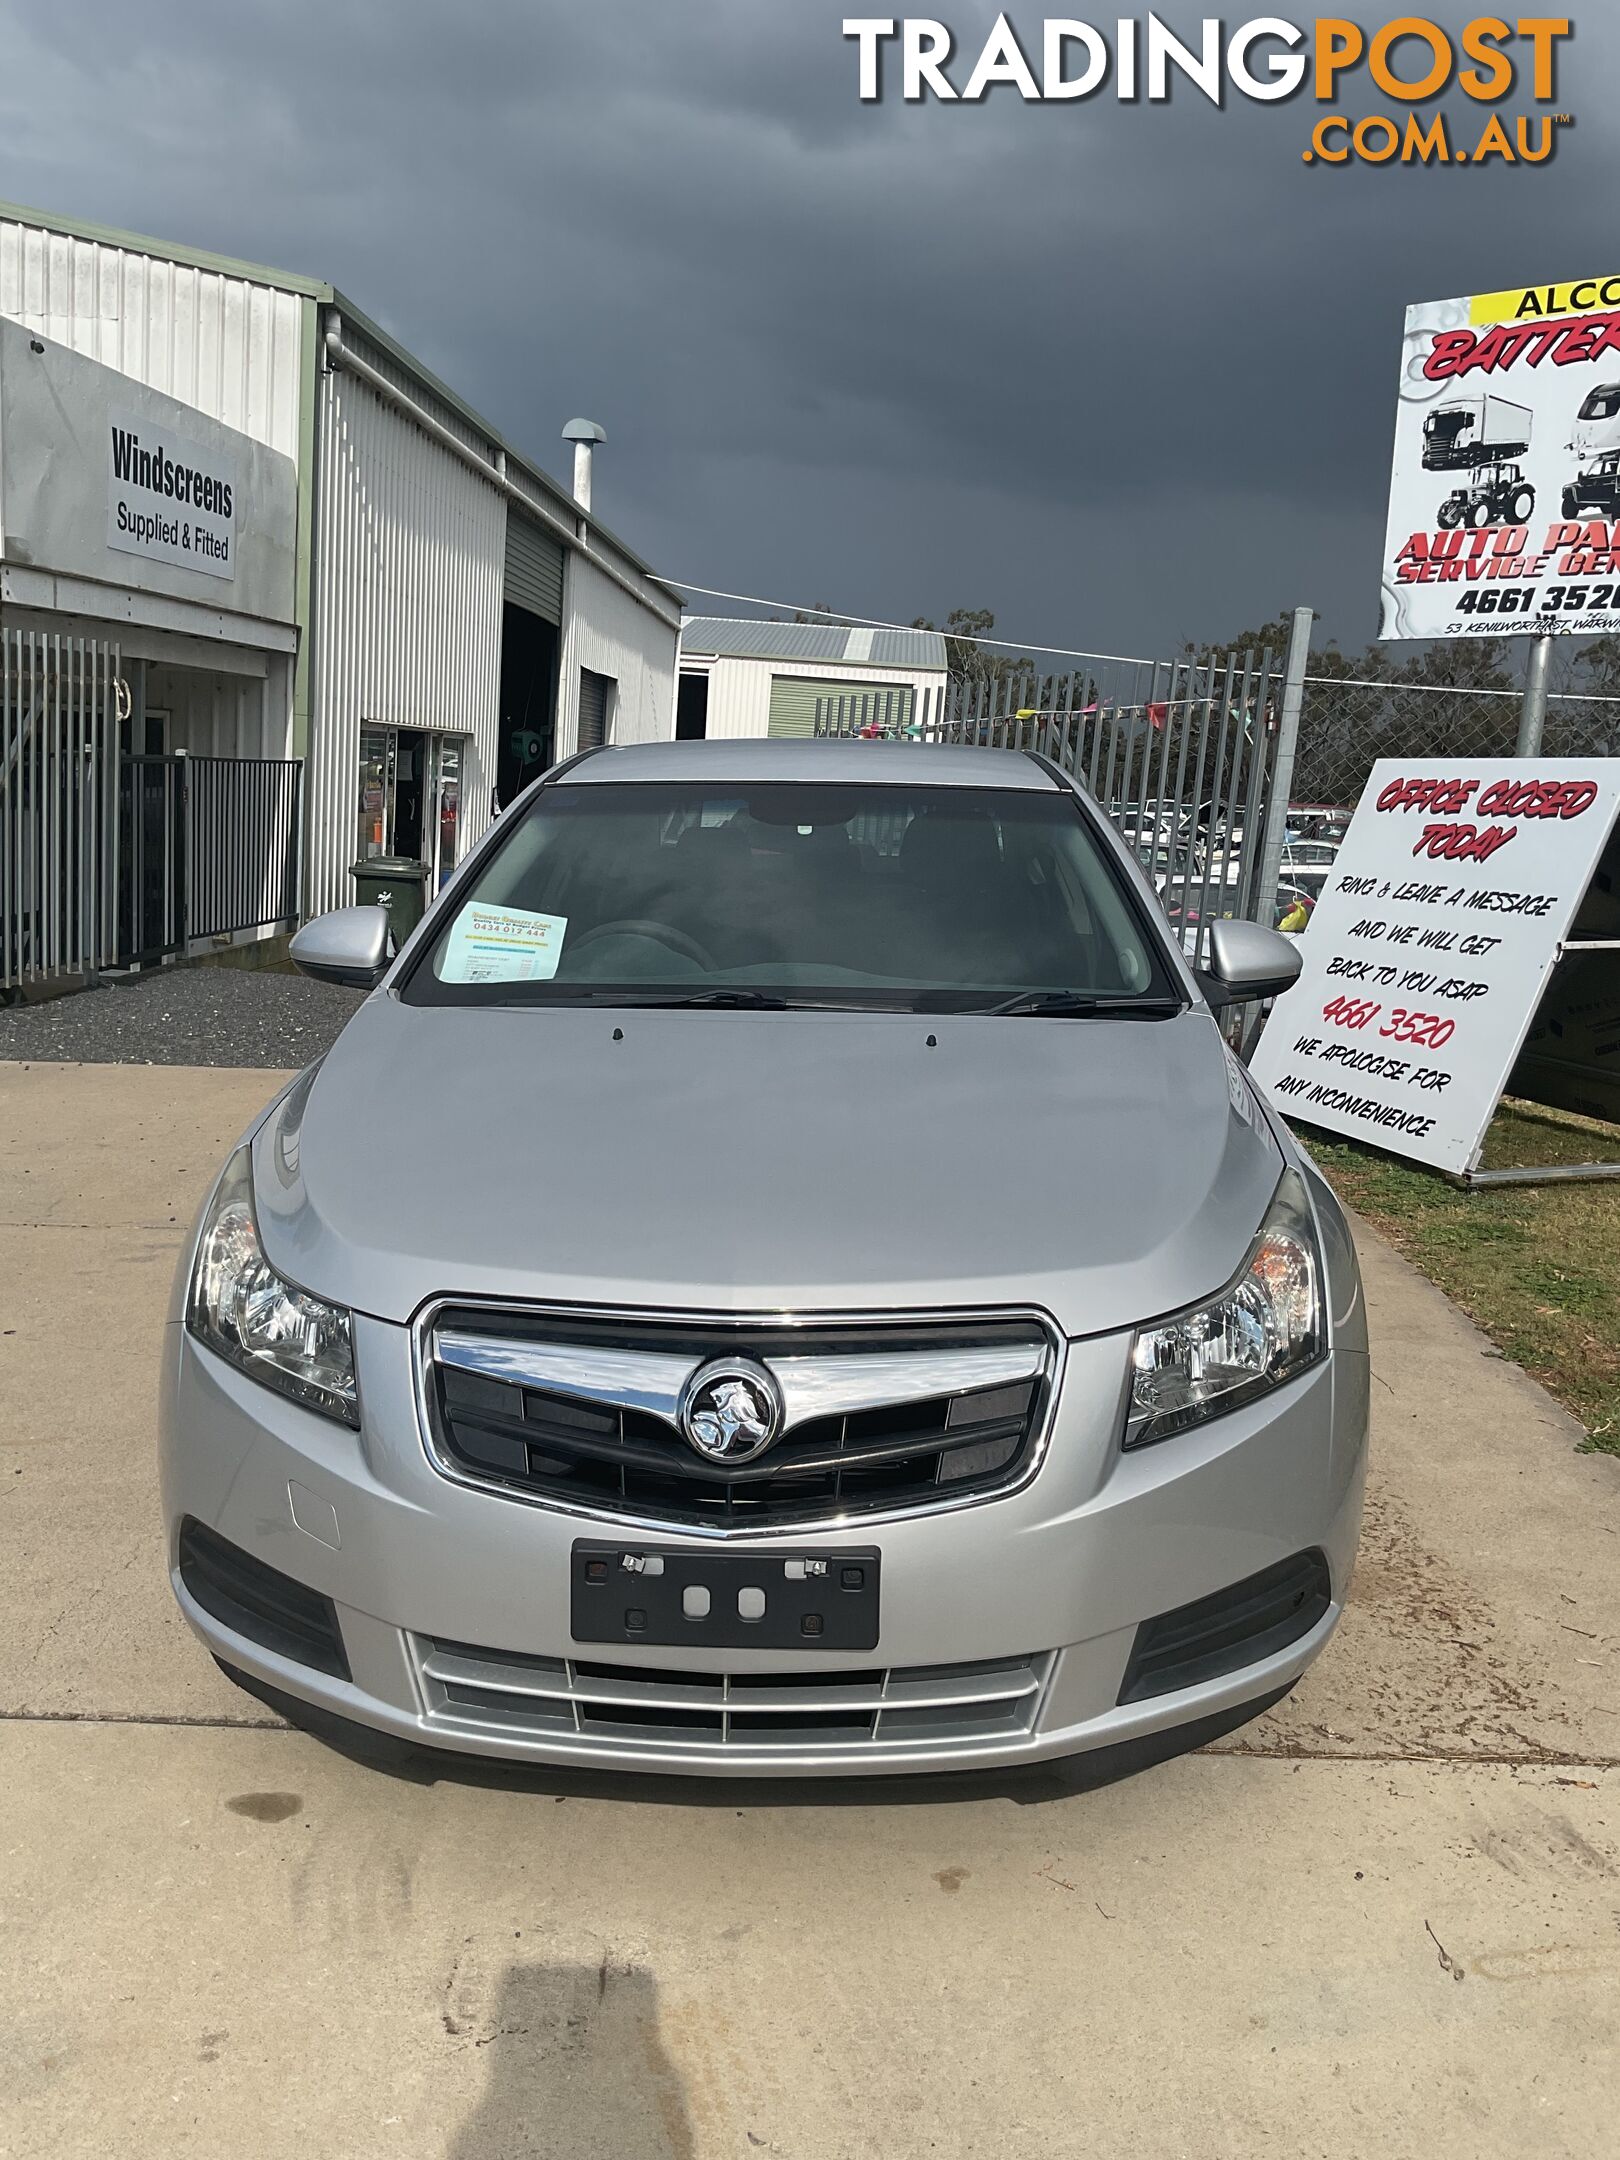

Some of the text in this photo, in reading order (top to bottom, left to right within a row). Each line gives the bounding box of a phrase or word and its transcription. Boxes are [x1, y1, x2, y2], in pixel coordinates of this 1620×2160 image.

[111, 426, 233, 519] Windscreens
[117, 501, 229, 561] Supplied & Fitted
[1393, 527, 1530, 563] AUTO
[1393, 554, 1550, 585] SERVICE
[1455, 587, 1536, 614] 4661
[1444, 623, 1463, 634] 53
[1465, 620, 1550, 633] KENILWORTH
[1551, 619, 1572, 630] ST
[1376, 778, 1598, 820] OFFICE CLOSED
[1413, 823, 1517, 863] TODAY
[1336, 876, 1558, 916] RING & LEAVE A MESSAGE
[1348, 919, 1502, 956] AND WE WILL GET
[1326, 956, 1489, 1001] BACK TO YOU ASAP
[1323, 995, 1455, 1049] 4661 3520
[1293, 1035, 1452, 1093] WE APOLOGISE FOR
[1274, 1074, 1437, 1138] ANY INCONVENIENCE
